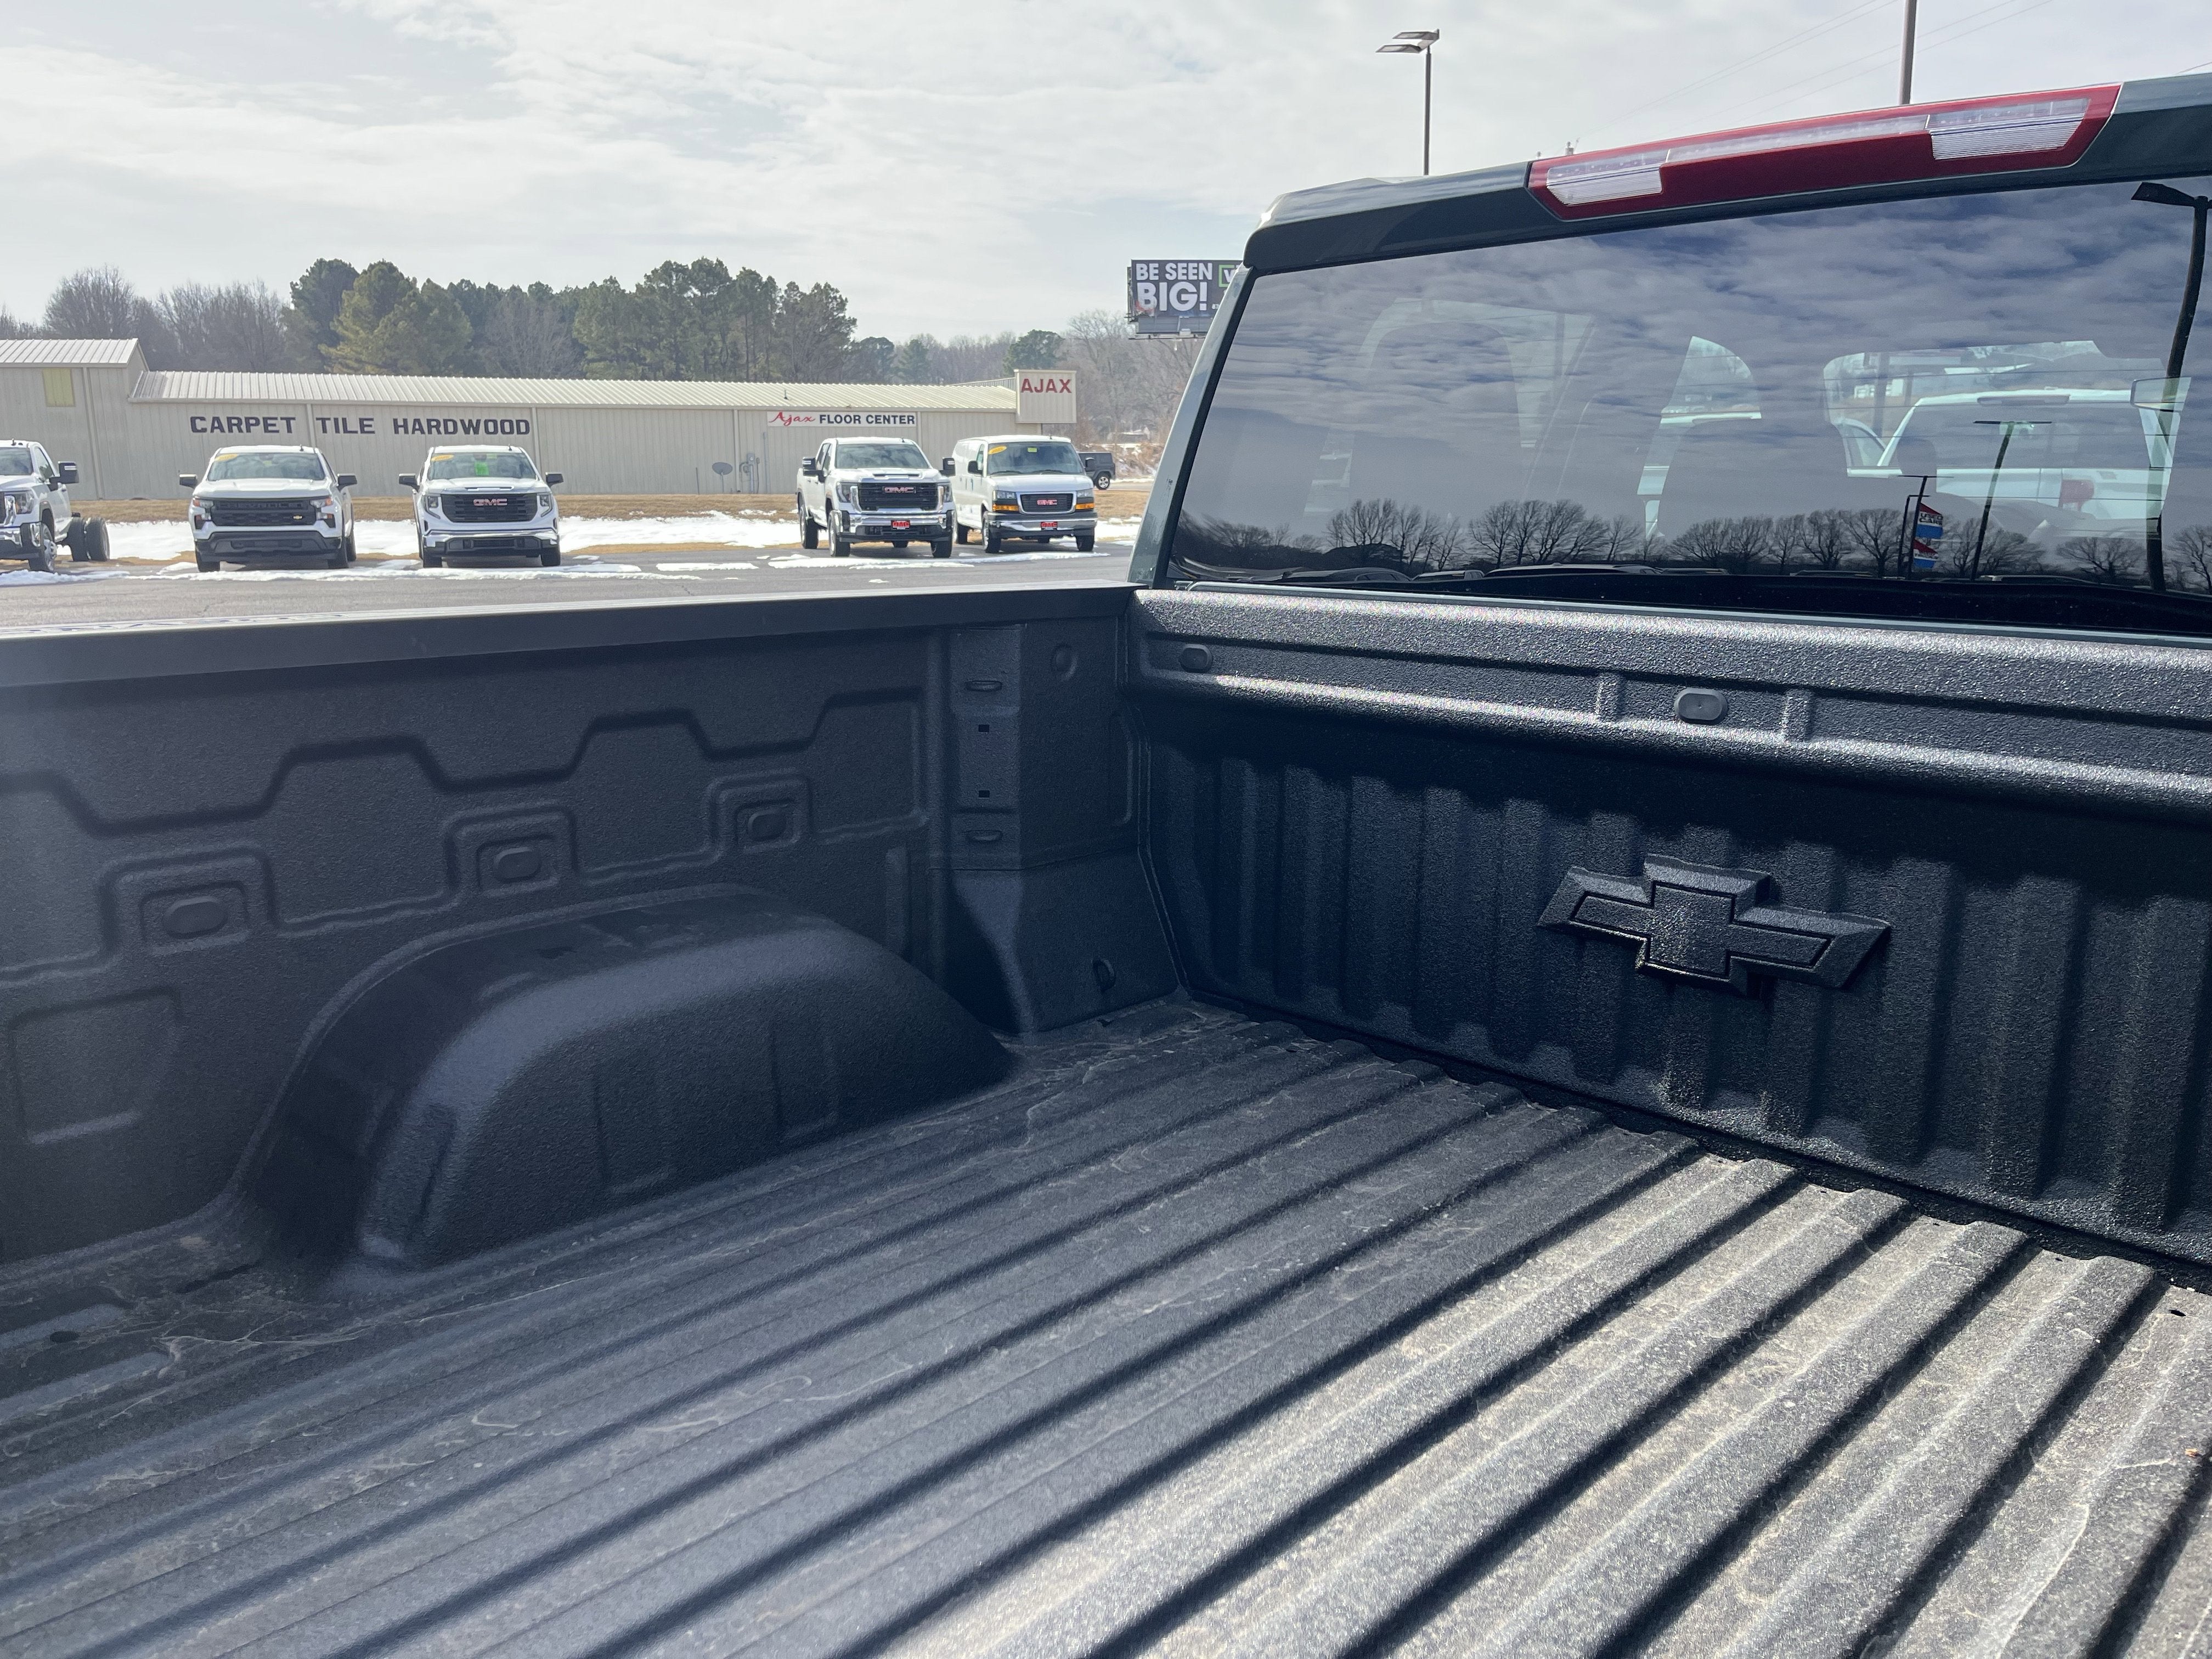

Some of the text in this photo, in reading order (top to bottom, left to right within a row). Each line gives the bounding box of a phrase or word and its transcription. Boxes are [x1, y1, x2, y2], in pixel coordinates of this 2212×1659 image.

[1136, 263, 1213, 280] BE SEEN
[1136, 281, 1207, 312] BIG!
[1020, 378, 1072, 393] AJAX
[190, 416, 530, 435] CARPET TILE HARDWOOD
[768, 411, 915, 426] Ajax FLOOR CENTER
[473, 498, 508, 506] GMC
